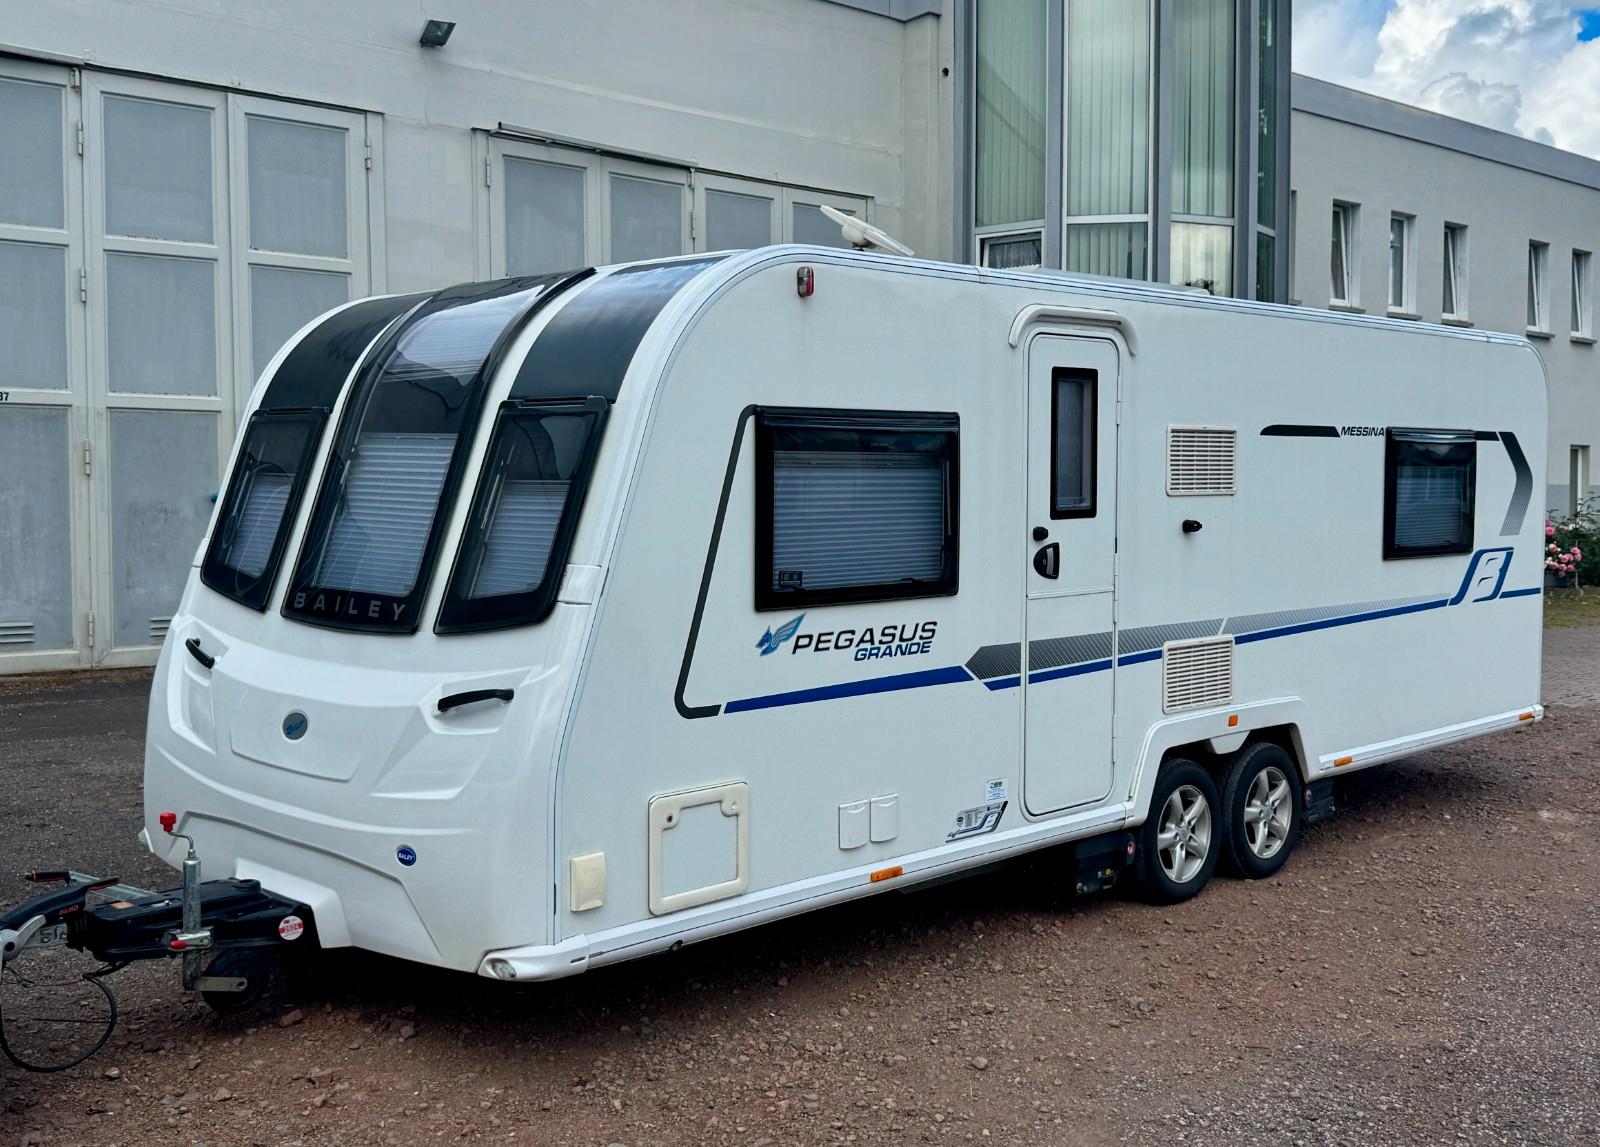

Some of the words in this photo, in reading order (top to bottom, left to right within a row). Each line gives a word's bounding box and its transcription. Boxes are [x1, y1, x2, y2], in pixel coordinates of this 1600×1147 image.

[1340, 425, 1385, 437] MESSINA
[293, 592, 406, 621] BAILEY
[792, 621, 938, 655] PEGASUS
[854, 640, 932, 662] GRANDE
